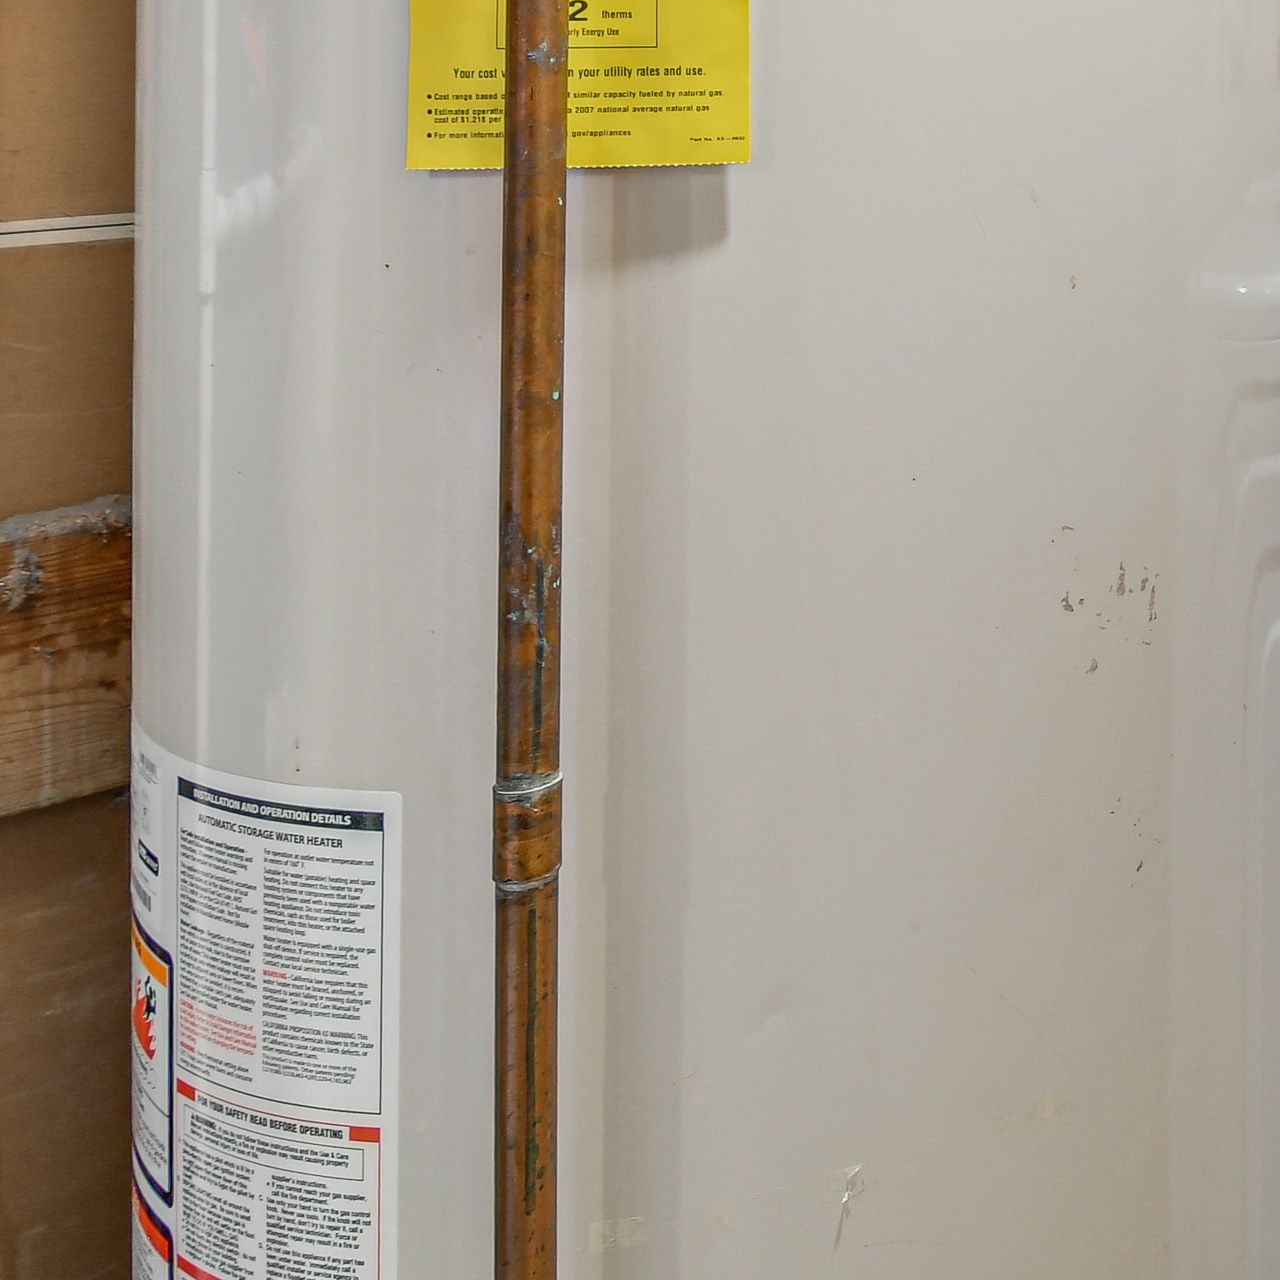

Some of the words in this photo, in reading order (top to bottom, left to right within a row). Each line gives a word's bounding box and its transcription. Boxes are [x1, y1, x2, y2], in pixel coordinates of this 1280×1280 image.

[601, 10, 633, 19] therms
[582, 28, 604, 37] Energy
[607, 28, 619, 36] Use
[453, 68, 475, 78] Your
[478, 68, 497, 78] cost
[578, 68, 600, 79] your
[604, 66, 632, 78] utility
[636, 67, 660, 77] rates
[663, 66, 682, 76] and
[603, 91, 636, 99] capacity
[639, 90, 663, 98] fueled
[666, 90, 675, 98] by
[678, 89, 706, 97] natural
[597, 105, 629, 113] national
[193, 788, 240, 809] INSTALLATION
[241, 802, 258, 814] AND
[260, 805, 311, 822] OPERATION
[312, 813, 352, 825] DETAILS
[198, 813, 236, 832] AUTOMATIC
[238, 824, 275, 840] STORAGE
[275, 831, 305, 845] WATER
[307, 836, 343, 849] HEATER
[209, 1100, 224, 1113] YOUR
[225, 1106, 248, 1121] SAFETY
[249, 1114, 268, 1128] READ
[269, 1119, 298, 1134] BEFORE
[299, 1124, 344, 1140] OPERATING
